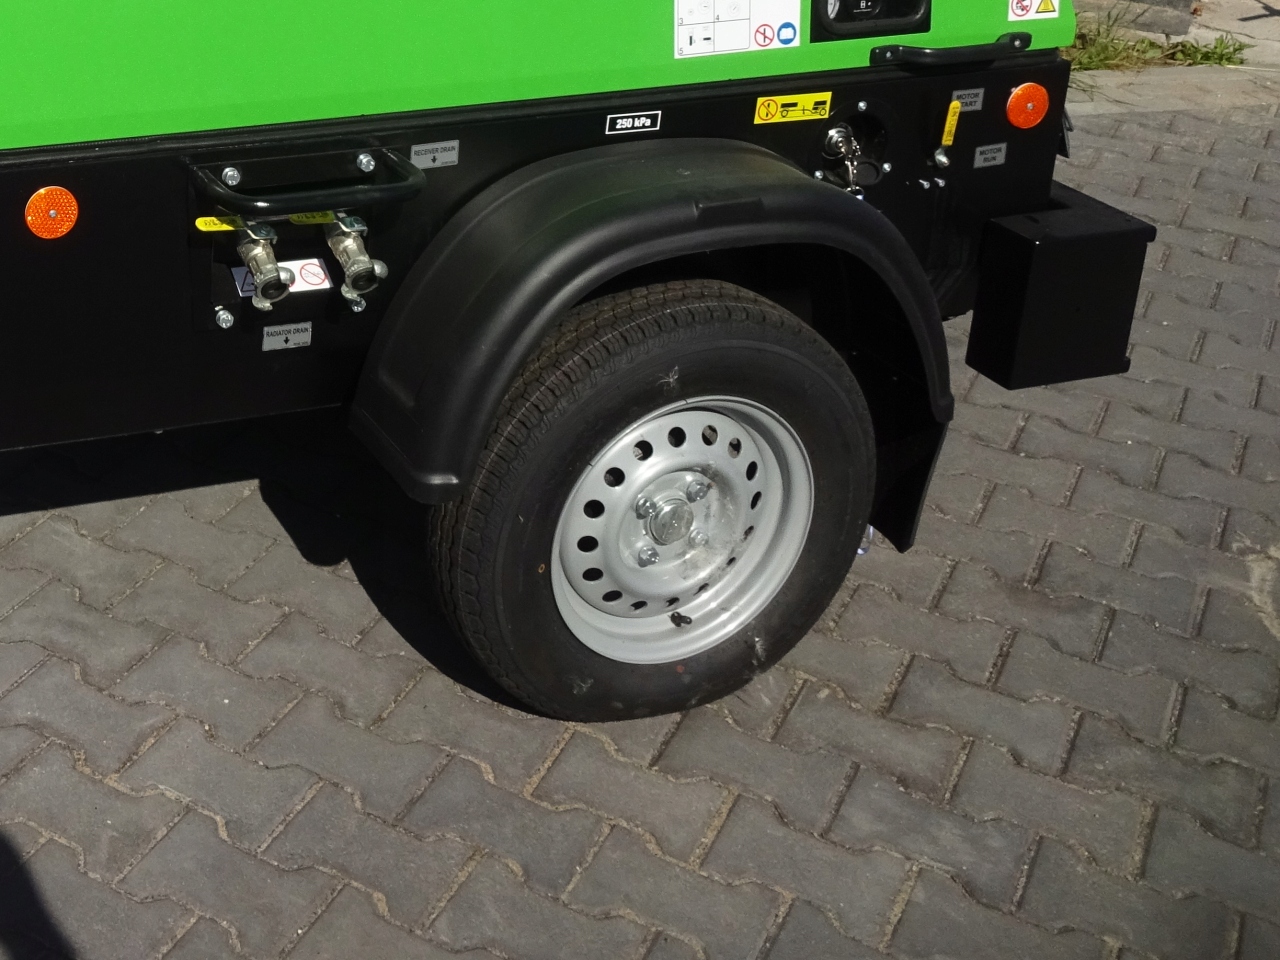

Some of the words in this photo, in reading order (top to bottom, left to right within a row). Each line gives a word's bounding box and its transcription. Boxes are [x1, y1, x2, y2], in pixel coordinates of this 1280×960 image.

[956, 92, 980, 100] MOTOR
[615, 118, 633, 129] 250
[634, 116, 651, 127] kPa
[413, 147, 439, 157] RECEIVER
[440, 145, 456, 153] DRAIN
[979, 146, 1002, 156] MOTOR
[983, 155, 997, 163] RUN
[266, 329, 292, 338] RADIATOR
[292, 327, 309, 335] DRAIN
